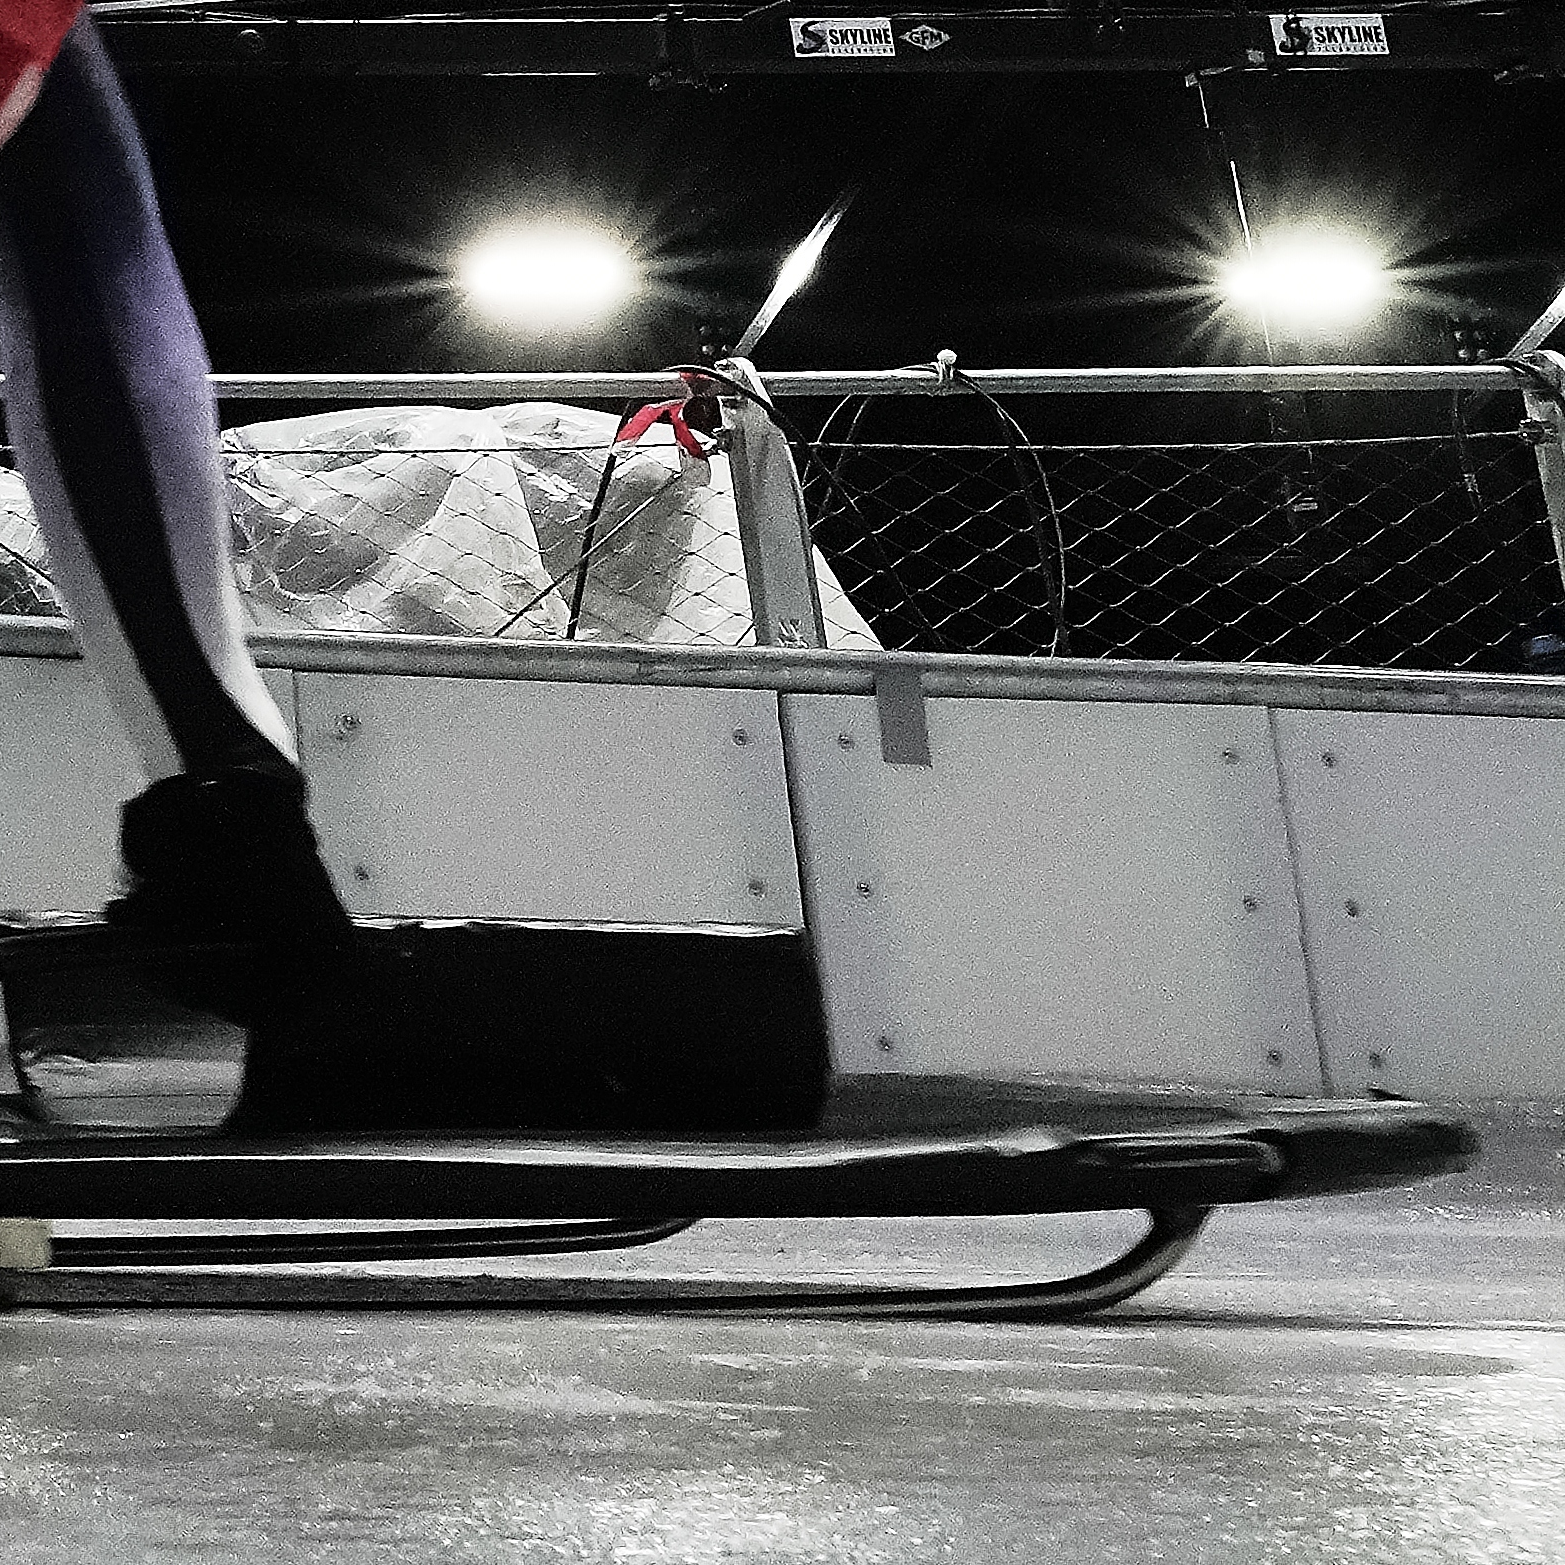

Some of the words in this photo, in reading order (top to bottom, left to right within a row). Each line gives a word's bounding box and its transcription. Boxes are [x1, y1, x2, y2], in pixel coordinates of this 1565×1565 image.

[828, 28, 892, 45] SKYLINE
[908, 29, 943, 46] GFM
[1314, 25, 1384, 43] SKYLINE
